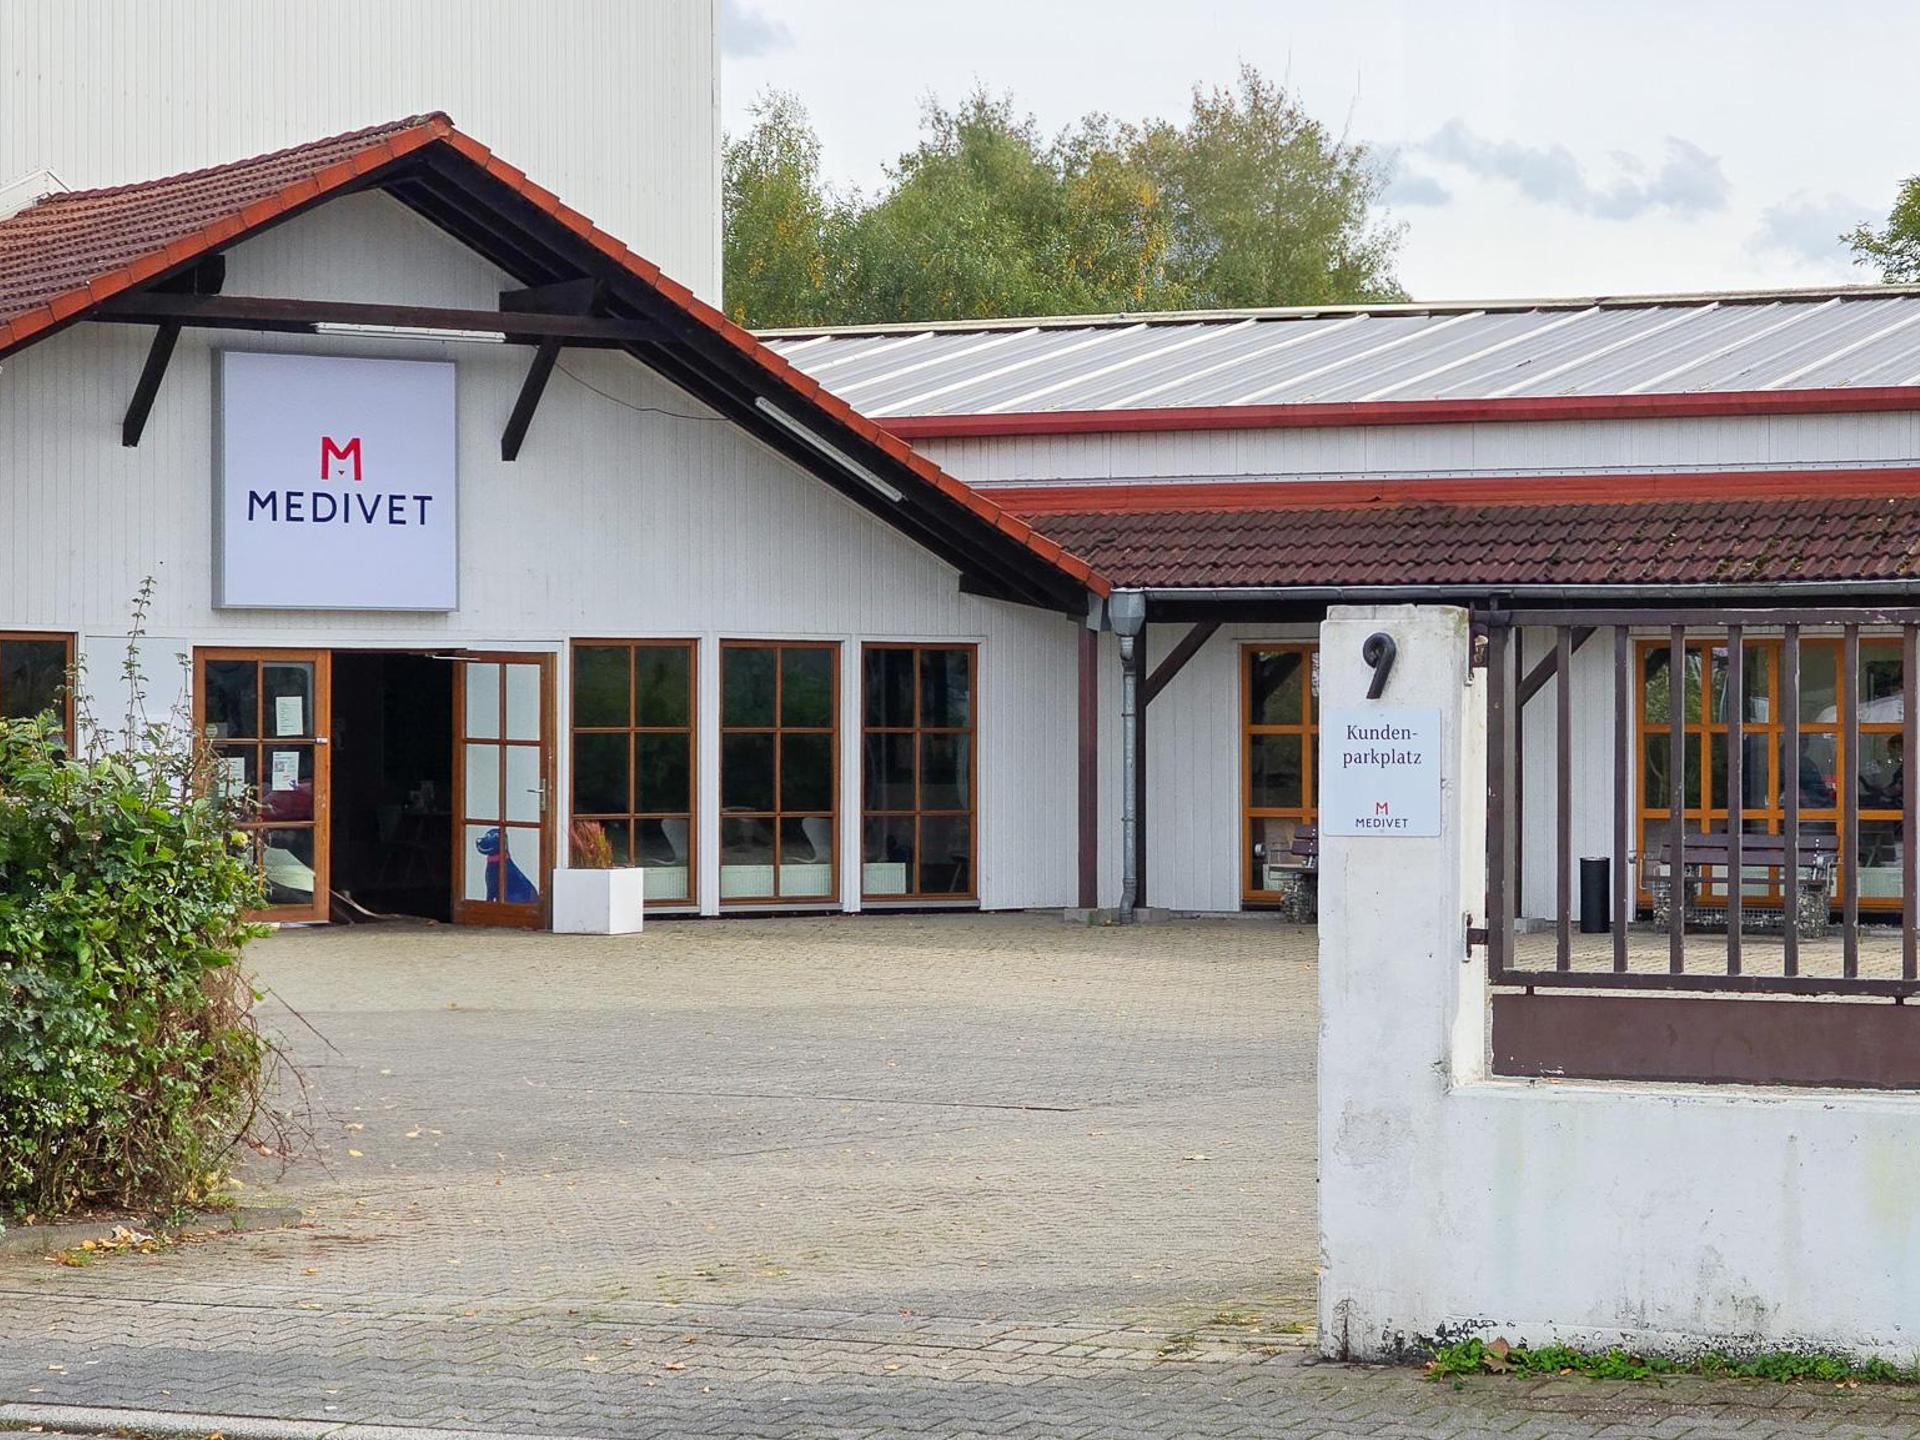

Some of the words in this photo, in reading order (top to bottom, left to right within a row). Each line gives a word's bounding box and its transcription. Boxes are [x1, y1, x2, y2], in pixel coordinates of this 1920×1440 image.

[248, 490, 433, 525] MEDIVET
[1362, 632, 1397, 700] 9
[1346, 724, 1419, 740] Kunden-
[1343, 748, 1423, 768] parkplatz
[1355, 818, 1409, 828] MEDIVET
